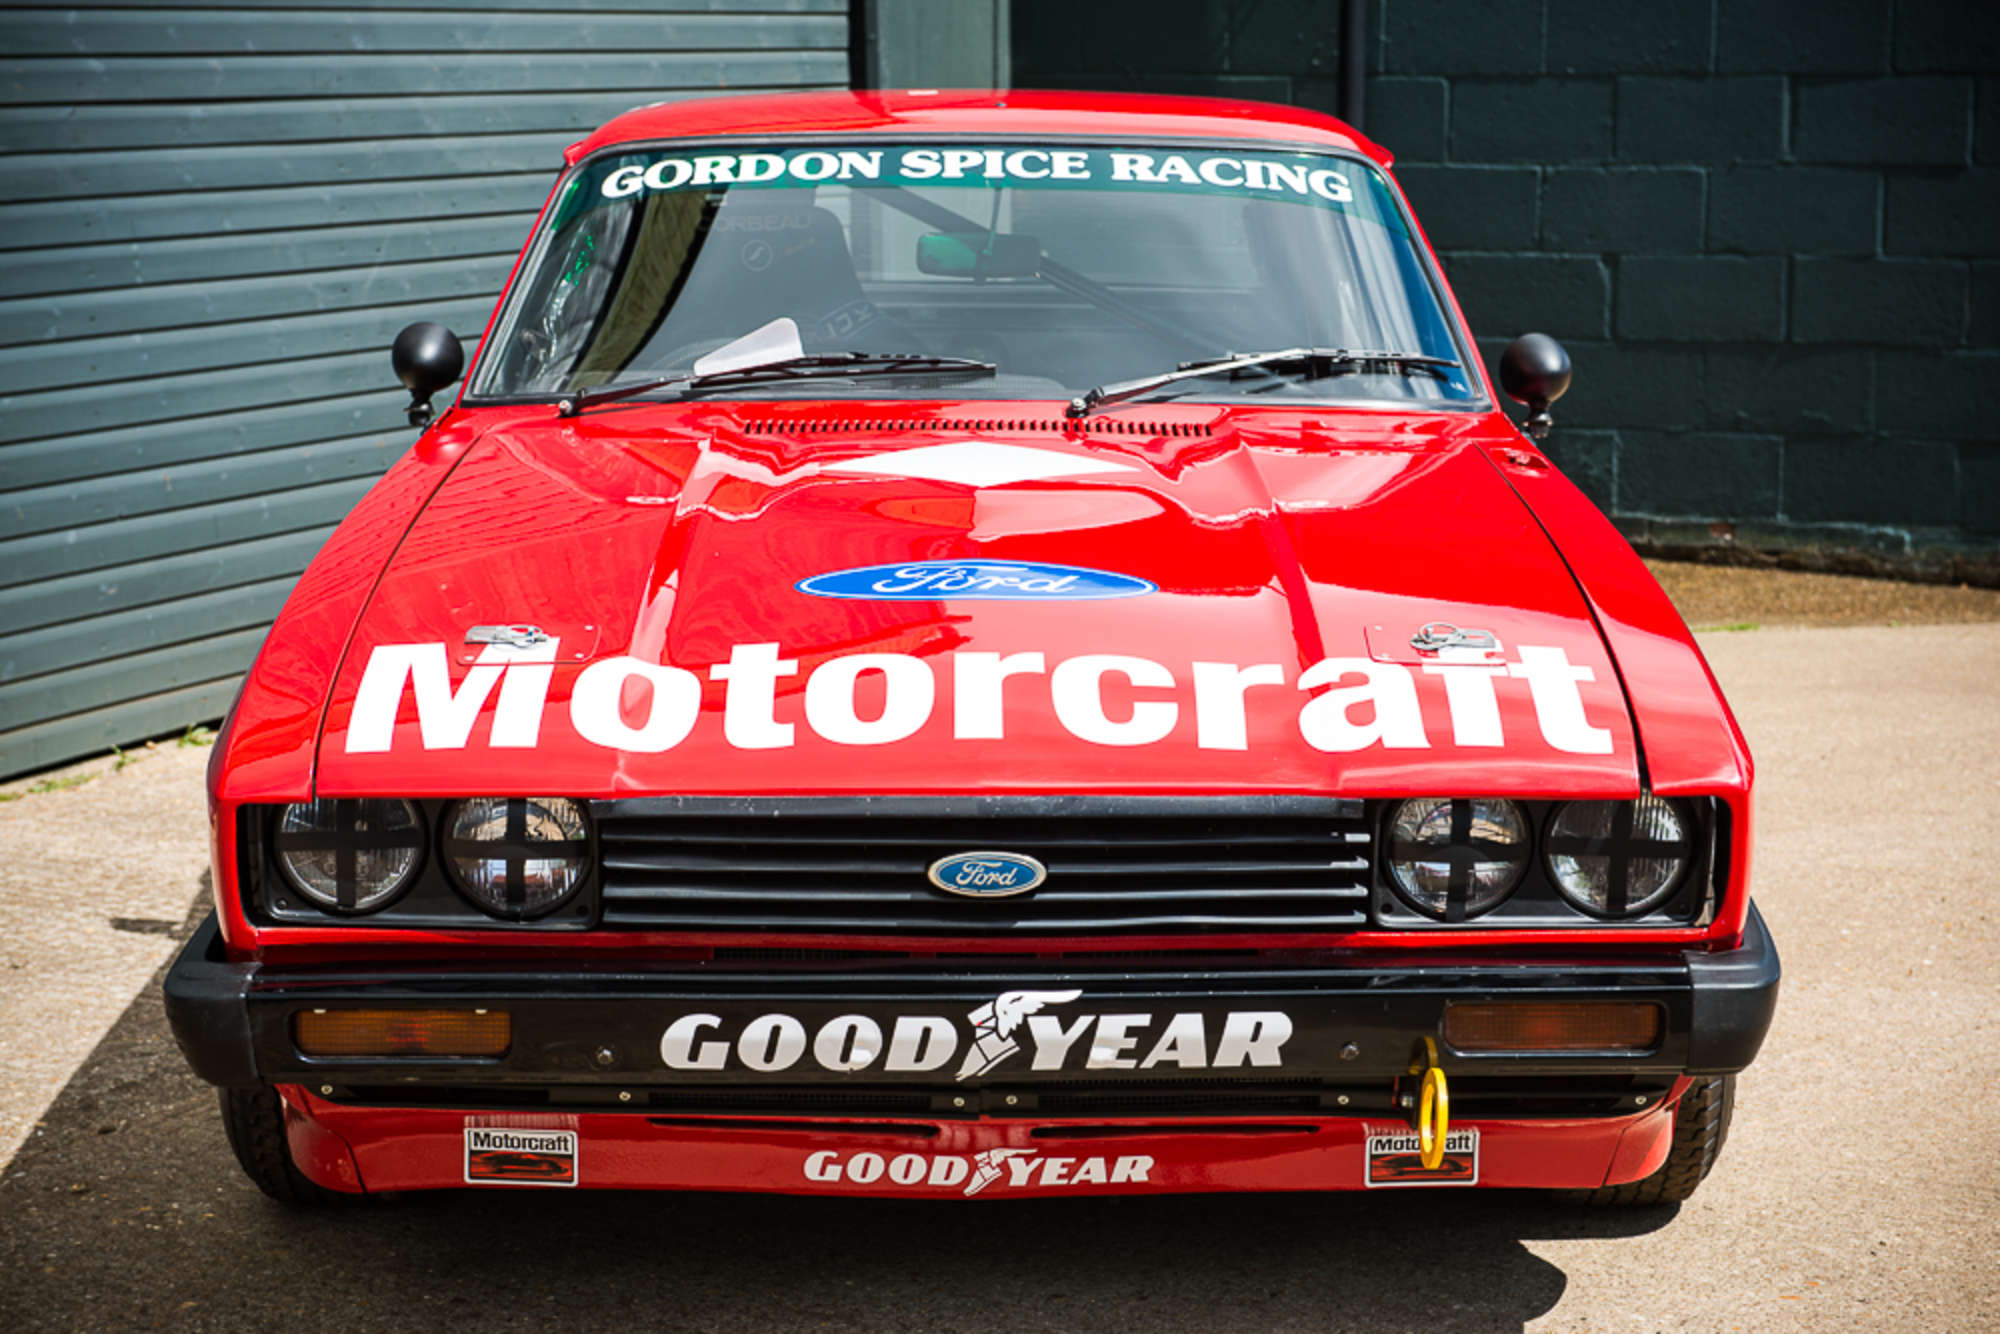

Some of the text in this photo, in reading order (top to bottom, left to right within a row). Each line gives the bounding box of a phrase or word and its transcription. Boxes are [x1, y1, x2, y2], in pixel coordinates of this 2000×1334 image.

[601, 150, 1353, 203] GORDON SPICE RACING
[872, 564, 1080, 593] Ford
[344, 637, 1614, 755] Motorcraft
[955, 861, 1018, 886] Ford
[473, 1131, 569, 1152] Motorcraft
[1374, 1133, 1470, 1152] Motoaft
